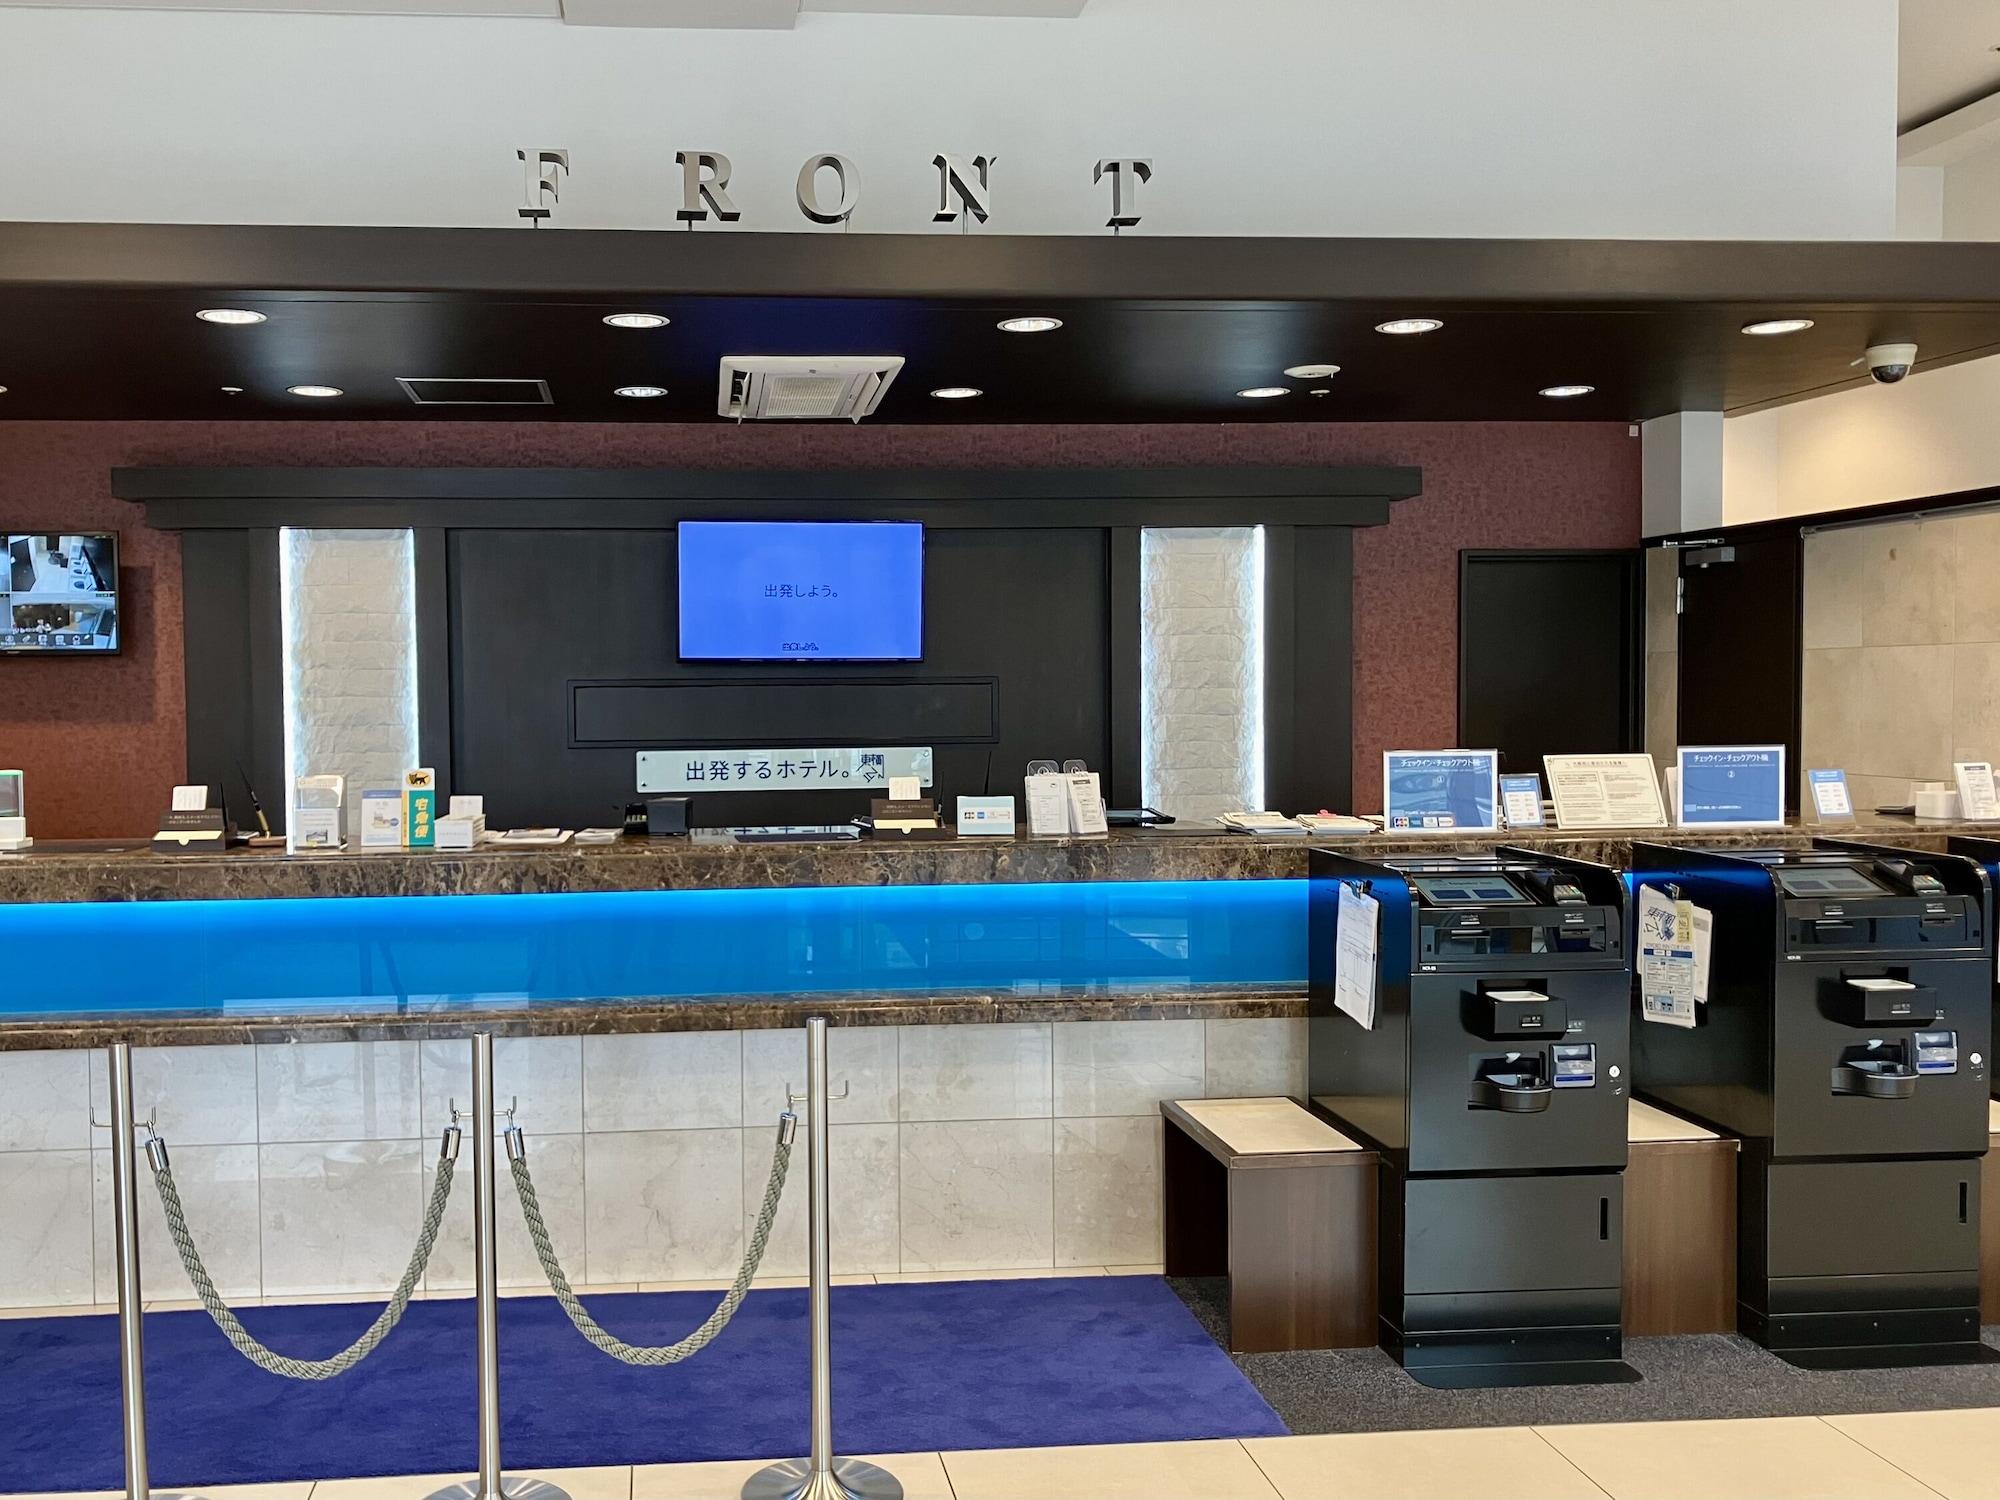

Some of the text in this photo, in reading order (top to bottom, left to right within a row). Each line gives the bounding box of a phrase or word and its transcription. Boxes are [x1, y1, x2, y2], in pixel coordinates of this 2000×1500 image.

[516, 148, 1153, 226] FRONT
[764, 583, 838, 598] 出発しよう。
[686, 760, 849, 781] 出発するホテル。
